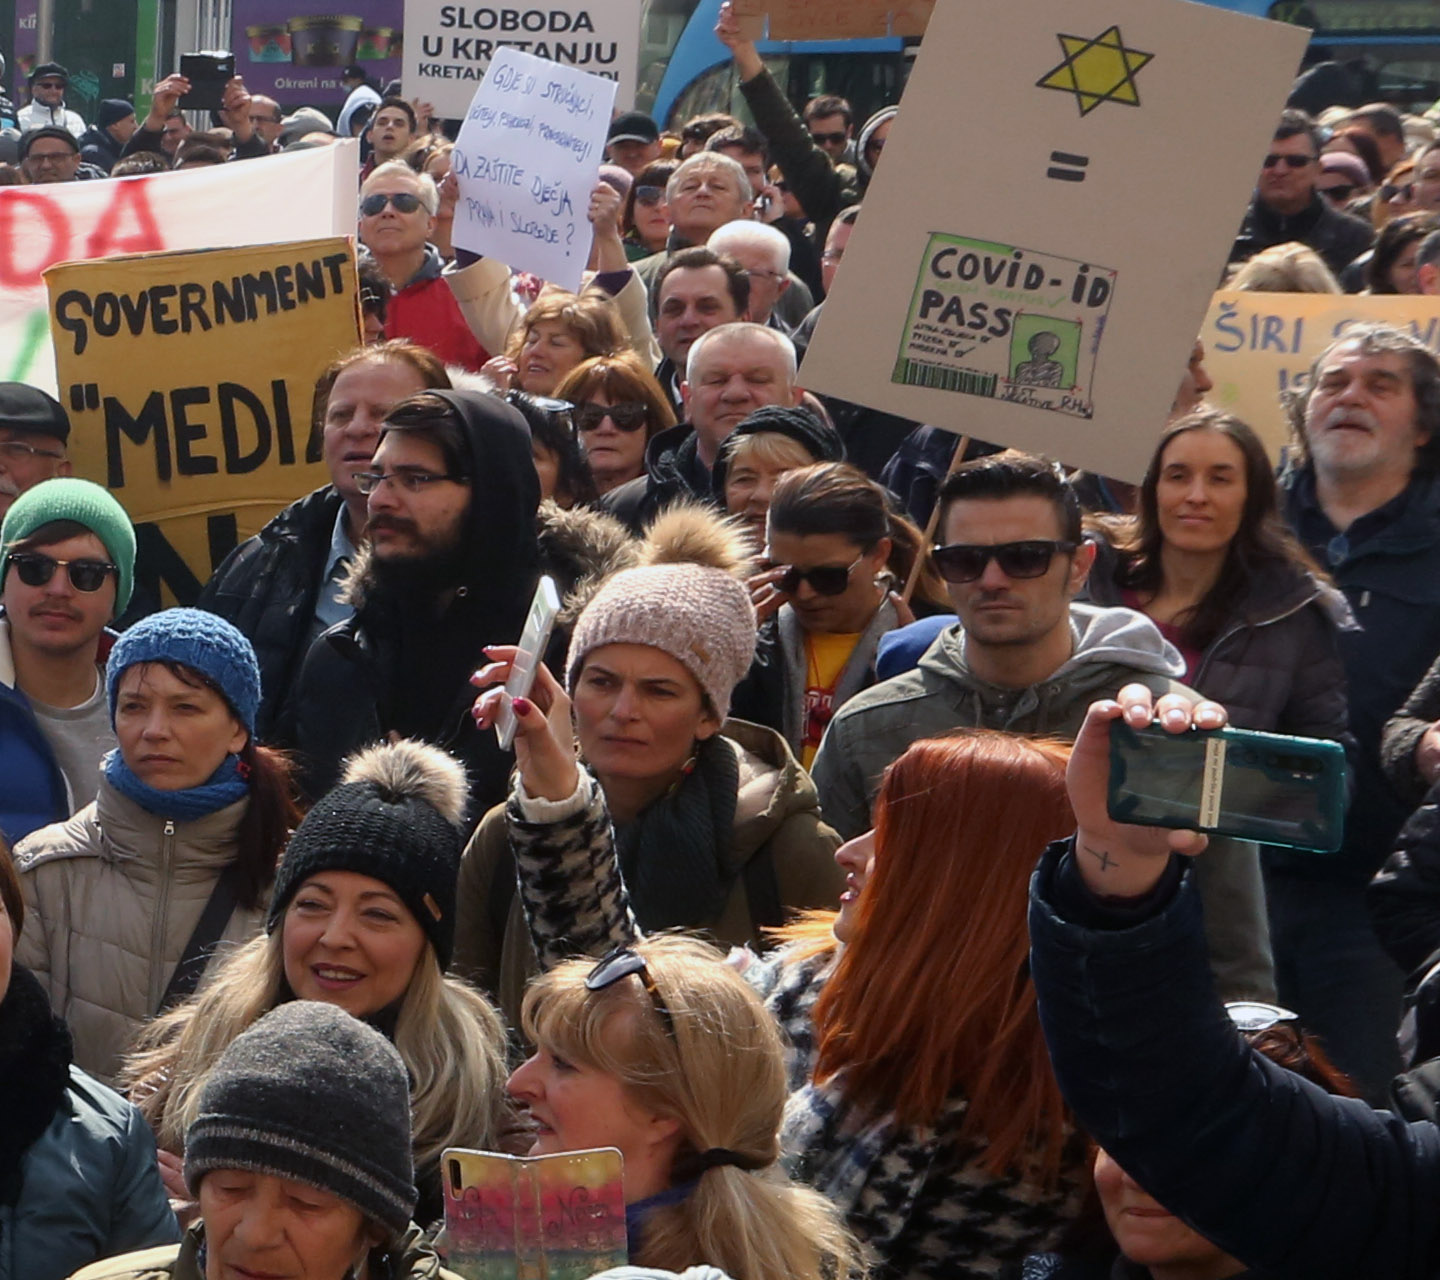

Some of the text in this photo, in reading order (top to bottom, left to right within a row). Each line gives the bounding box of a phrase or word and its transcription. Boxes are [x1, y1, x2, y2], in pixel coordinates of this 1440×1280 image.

[440, 5, 595, 34] SLOBODA
[422, 35, 443, 58] U
[418, 63, 485, 83] KRETAN
[473, 155, 524, 186] ZAŠTITE
[55, 252, 349, 356] GOVERNMENT
[919, 288, 1012, 338] PASS
[1213, 299, 1305, 354] ŠIRI
